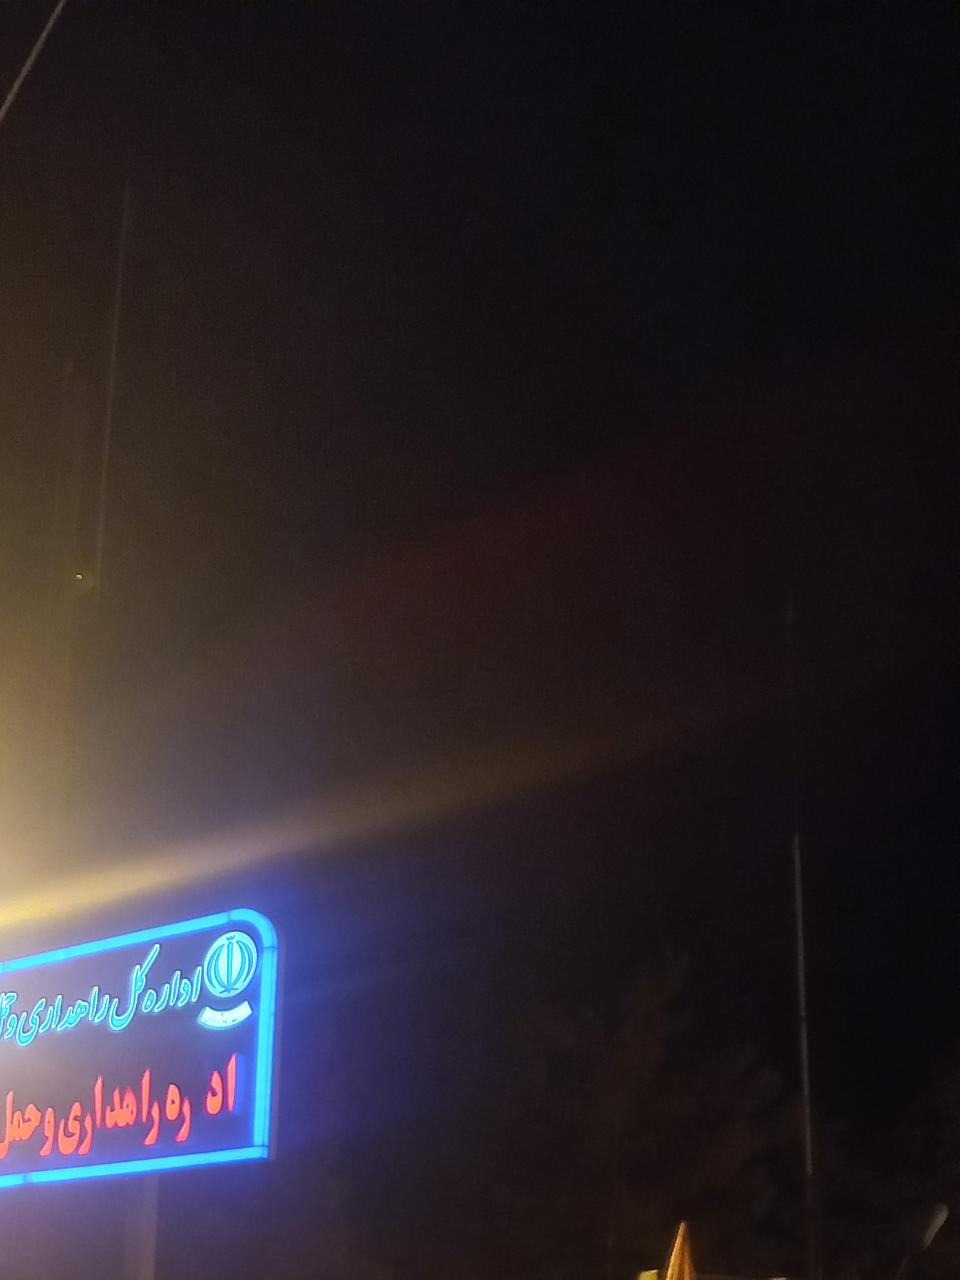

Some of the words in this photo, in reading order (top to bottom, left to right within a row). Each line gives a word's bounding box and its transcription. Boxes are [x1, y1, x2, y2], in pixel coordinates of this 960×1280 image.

[109, 943, 161, 1030] کل
[142, 965, 203, 1014] اداره
[3, 1014, 18, 1040] و
[15, 986, 111, 1047] راهداری
[40, 1106, 56, 1156] و
[58, 1067, 161, 1156] راهداری
